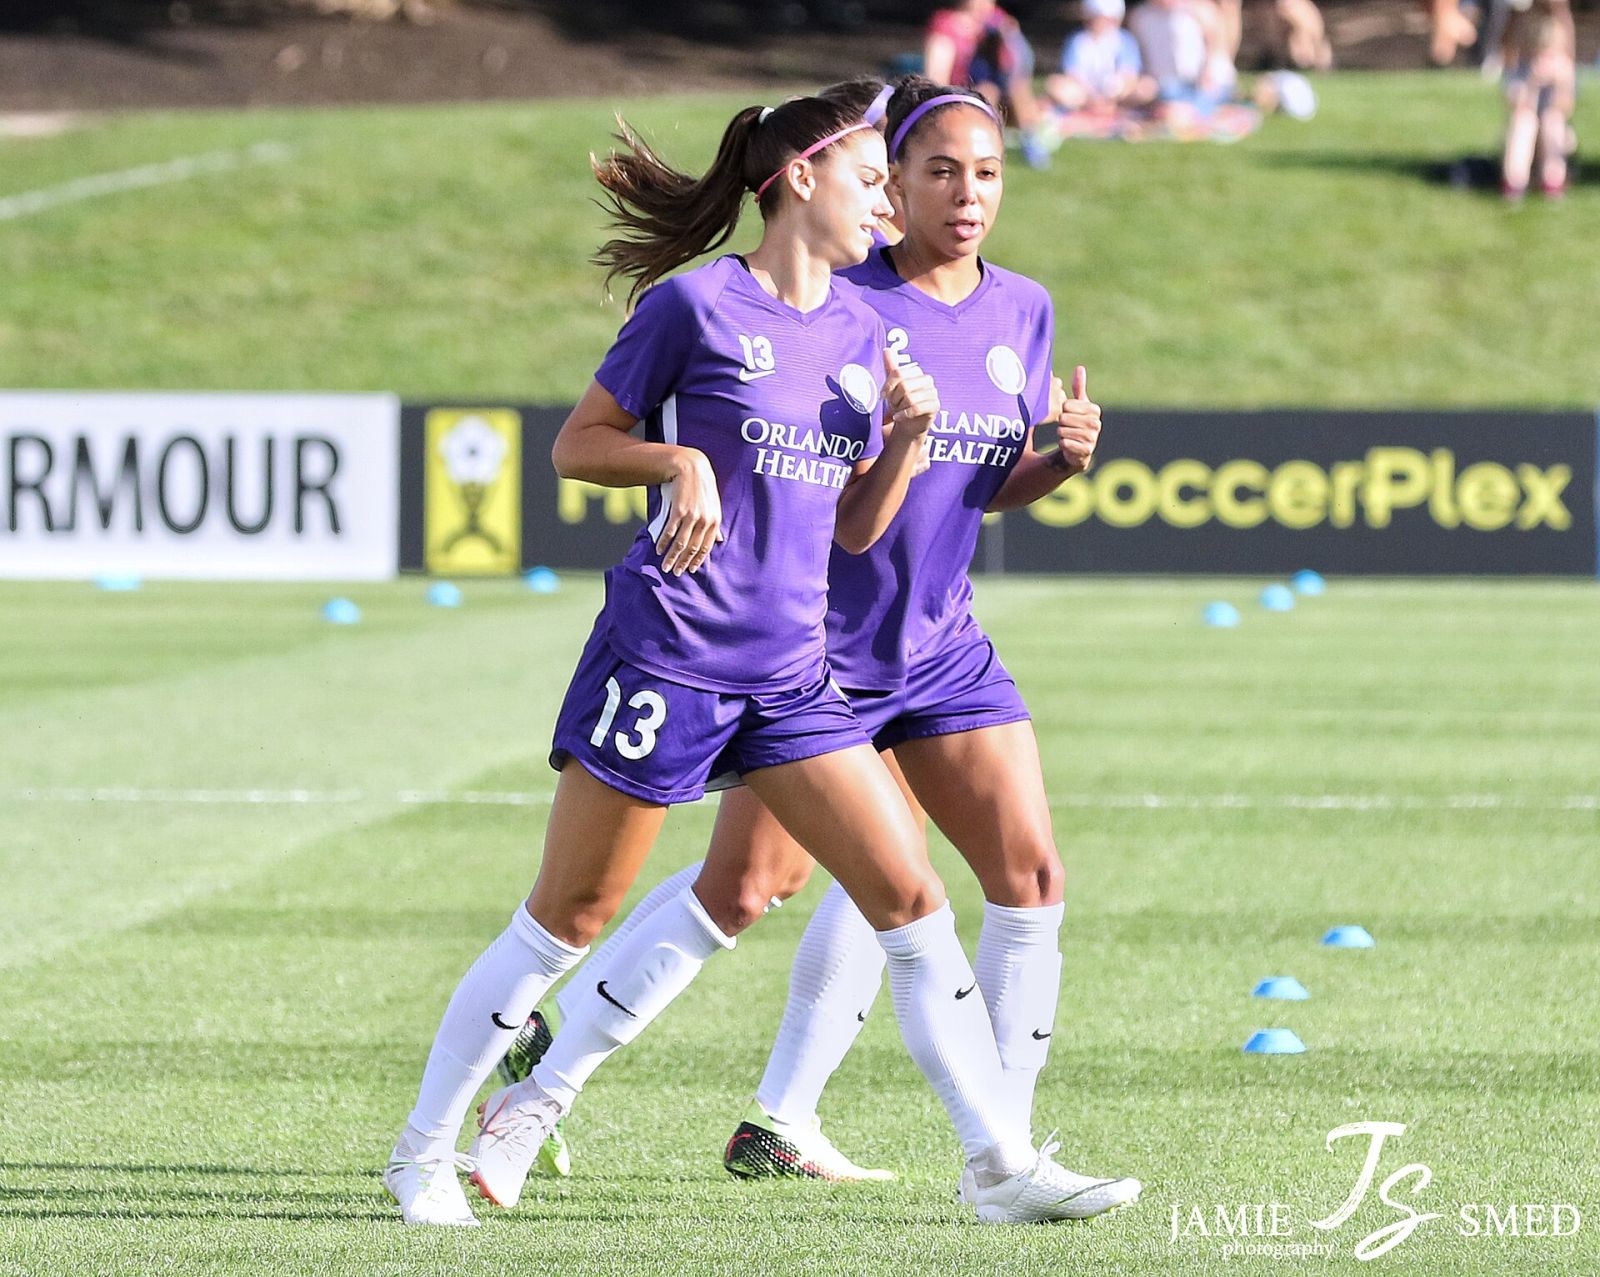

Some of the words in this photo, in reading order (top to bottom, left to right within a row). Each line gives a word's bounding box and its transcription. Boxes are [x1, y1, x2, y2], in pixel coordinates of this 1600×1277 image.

[738, 334, 776, 371] 13
[741, 417, 864, 461] ORLANDO
[929, 410, 1026, 441] LANDO
[752, 447, 850, 490] HEALTH
[1029, 444, 1573, 530] SoccerPlex
[589, 676, 667, 760] 13
